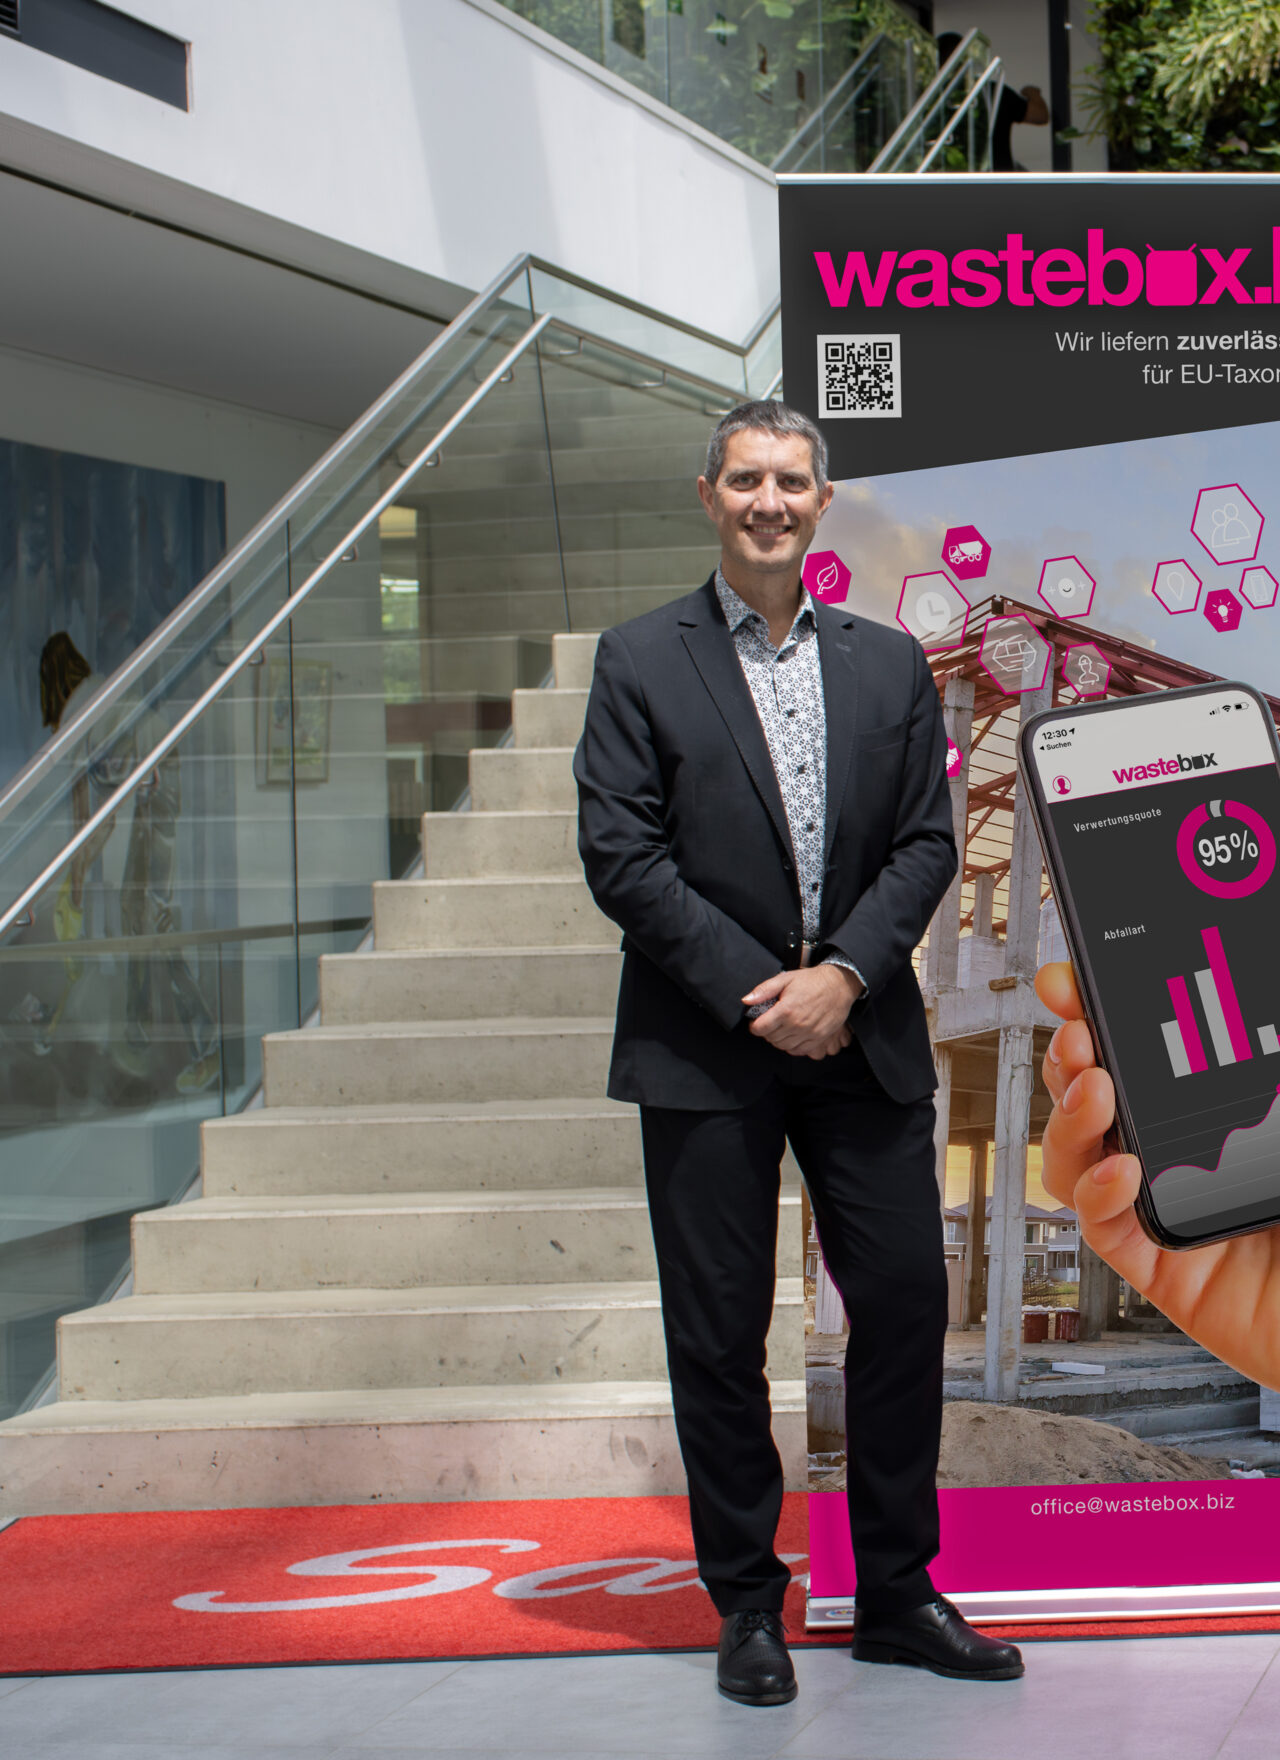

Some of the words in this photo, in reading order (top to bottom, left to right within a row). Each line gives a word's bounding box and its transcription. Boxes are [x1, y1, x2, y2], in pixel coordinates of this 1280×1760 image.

[1055, 331, 1094, 352] Wir
[1101, 330, 1169, 352] liefern
[1142, 364, 1174, 385] für
[1041, 728, 1068, 741] 12:30
[1046, 740, 1072, 751] Suchen
[1073, 808, 1162, 833] Verwertungsquote
[1198, 829, 1259, 867] 95%
[1104, 924, 1146, 941] Abfallart
[1030, 1492, 1236, 1516] office@wastebox.biz
